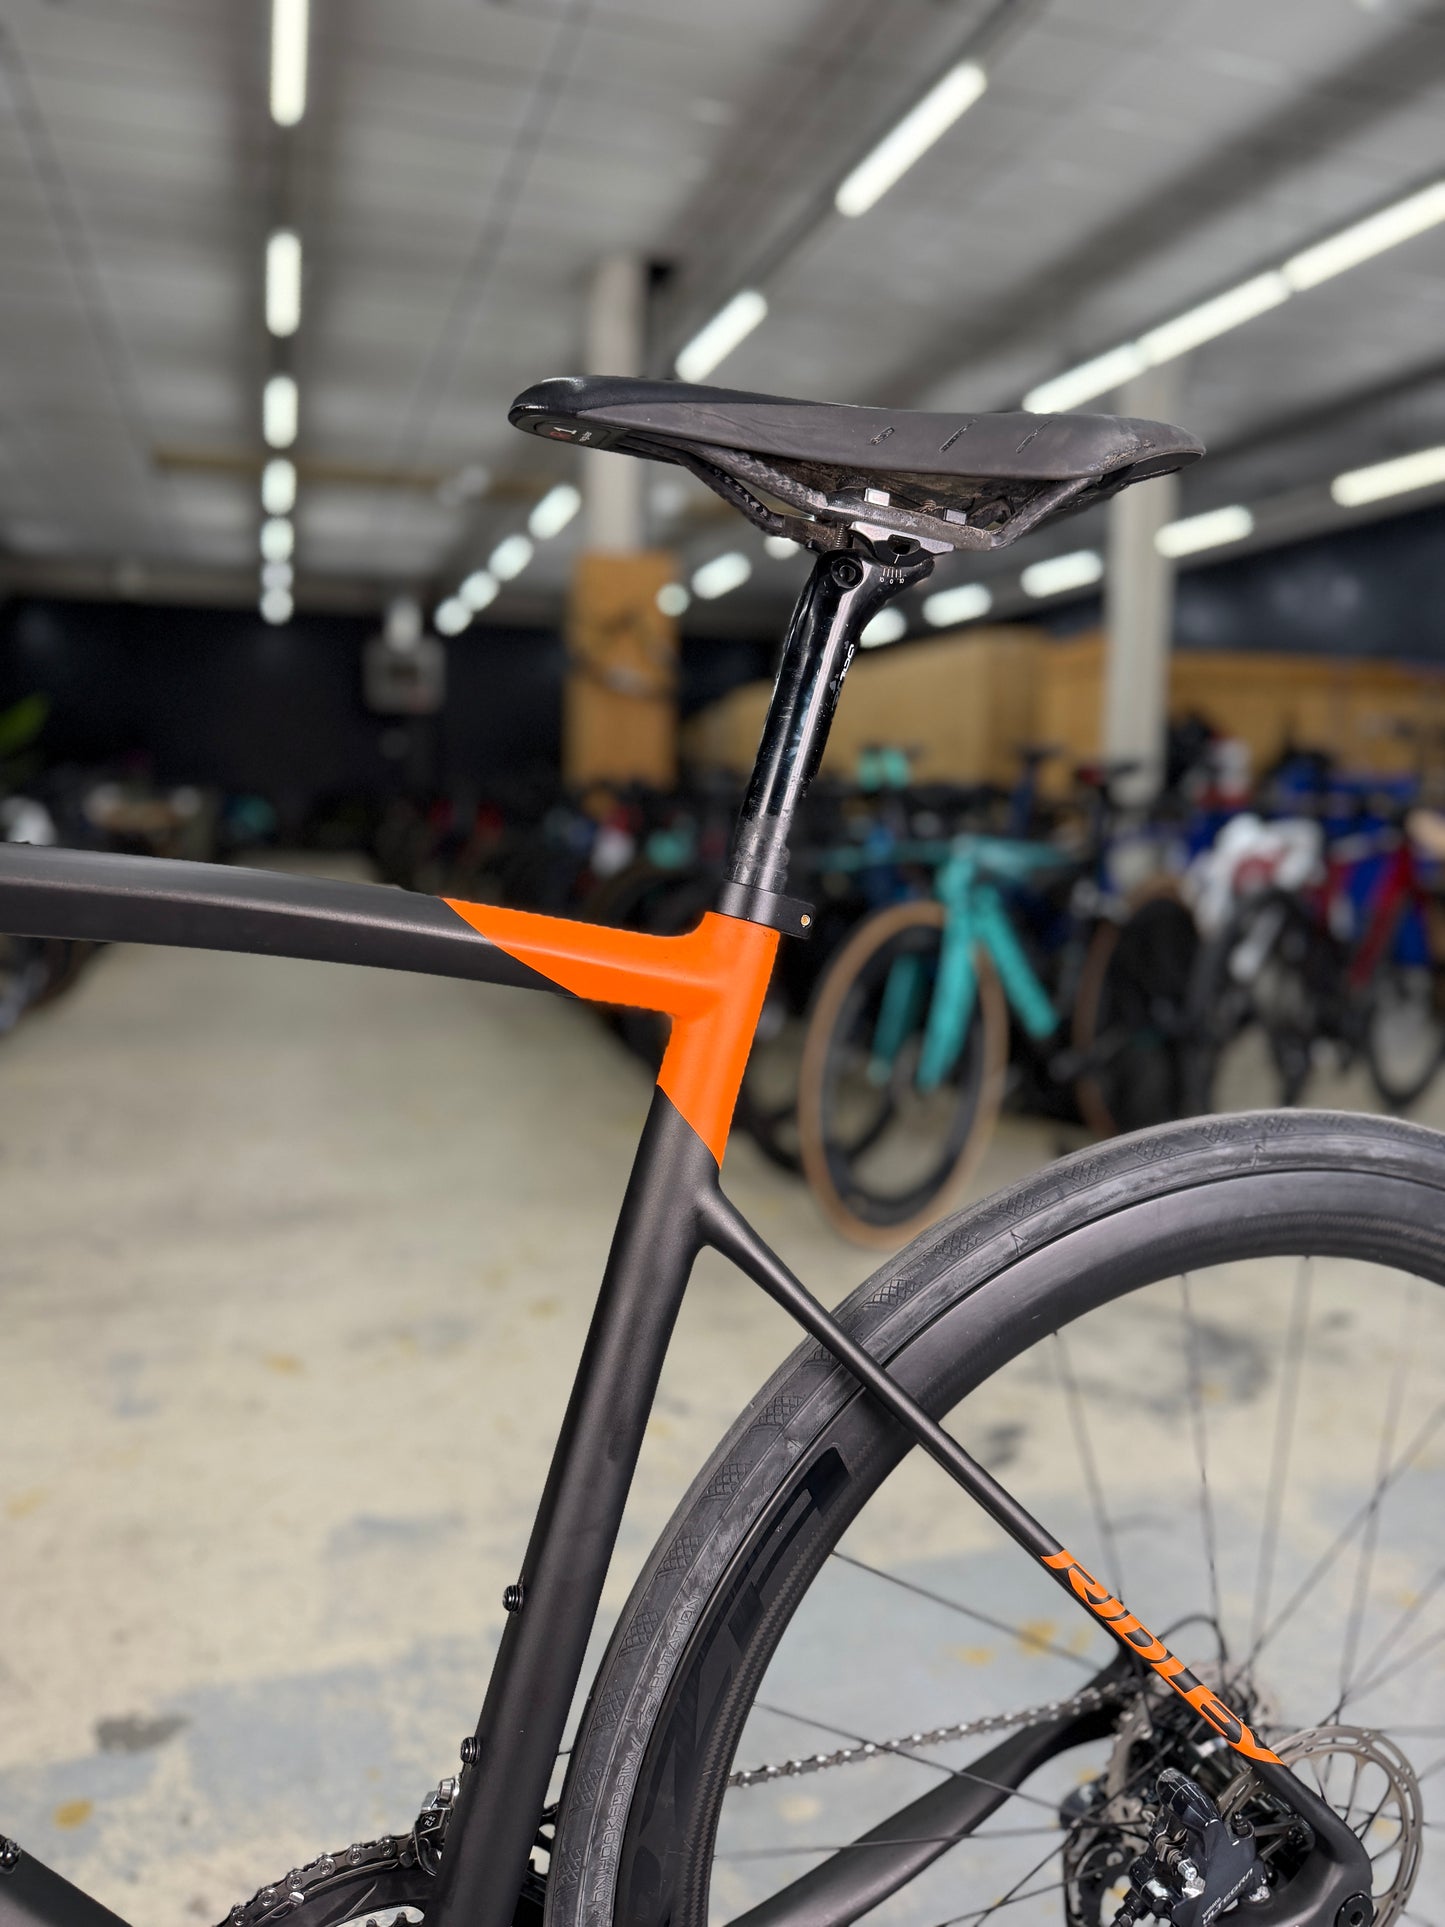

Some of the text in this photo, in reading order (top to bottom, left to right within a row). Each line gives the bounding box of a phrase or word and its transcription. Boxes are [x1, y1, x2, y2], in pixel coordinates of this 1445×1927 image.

[649, 1594, 700, 1689] ROTATION
[1040, 1548, 1285, 1766] RIDLEY
[597, 1791, 625, 1875] HOOKED
[1202, 1867, 1253, 1925] ULTEGRA
